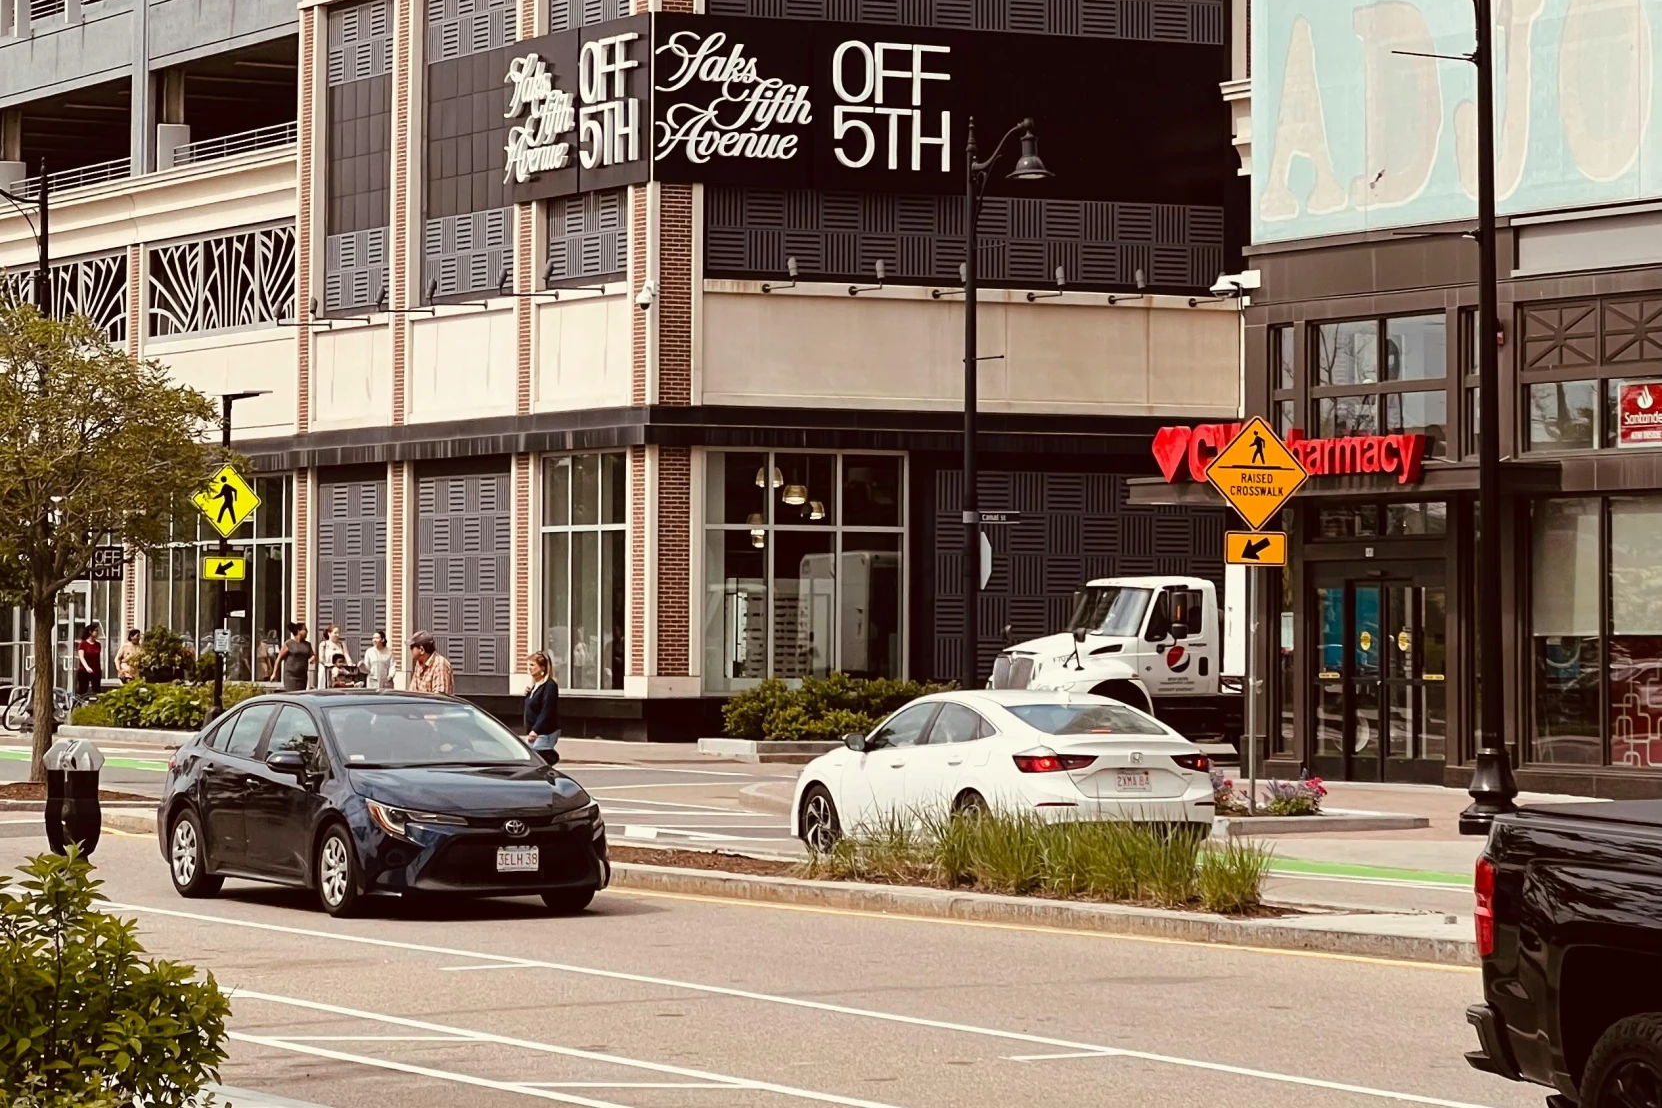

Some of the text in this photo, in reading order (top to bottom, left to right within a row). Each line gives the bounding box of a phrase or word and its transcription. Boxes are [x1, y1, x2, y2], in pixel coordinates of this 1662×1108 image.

[504, 53, 552, 118] Saks
[579, 32, 639, 104] OFF
[655, 31, 758, 92] Saks
[833, 40, 951, 106] OFF
[526, 89, 576, 148] Fifth
[579, 98, 639, 170] 5TH
[655, 103, 799, 164] Avenue
[710, 78, 813, 132] Fifth
[503, 126, 569, 185] Avenue
[833, 105, 951, 173] 5TH
[1240, 473, 1274, 484] RAISED
[1285, 428, 1425, 484] harmacy
[1230, 485, 1285, 497] CROSSWALK
[94, 550, 121, 564] OFF
[498, 853, 538, 866] 3ELH 38
